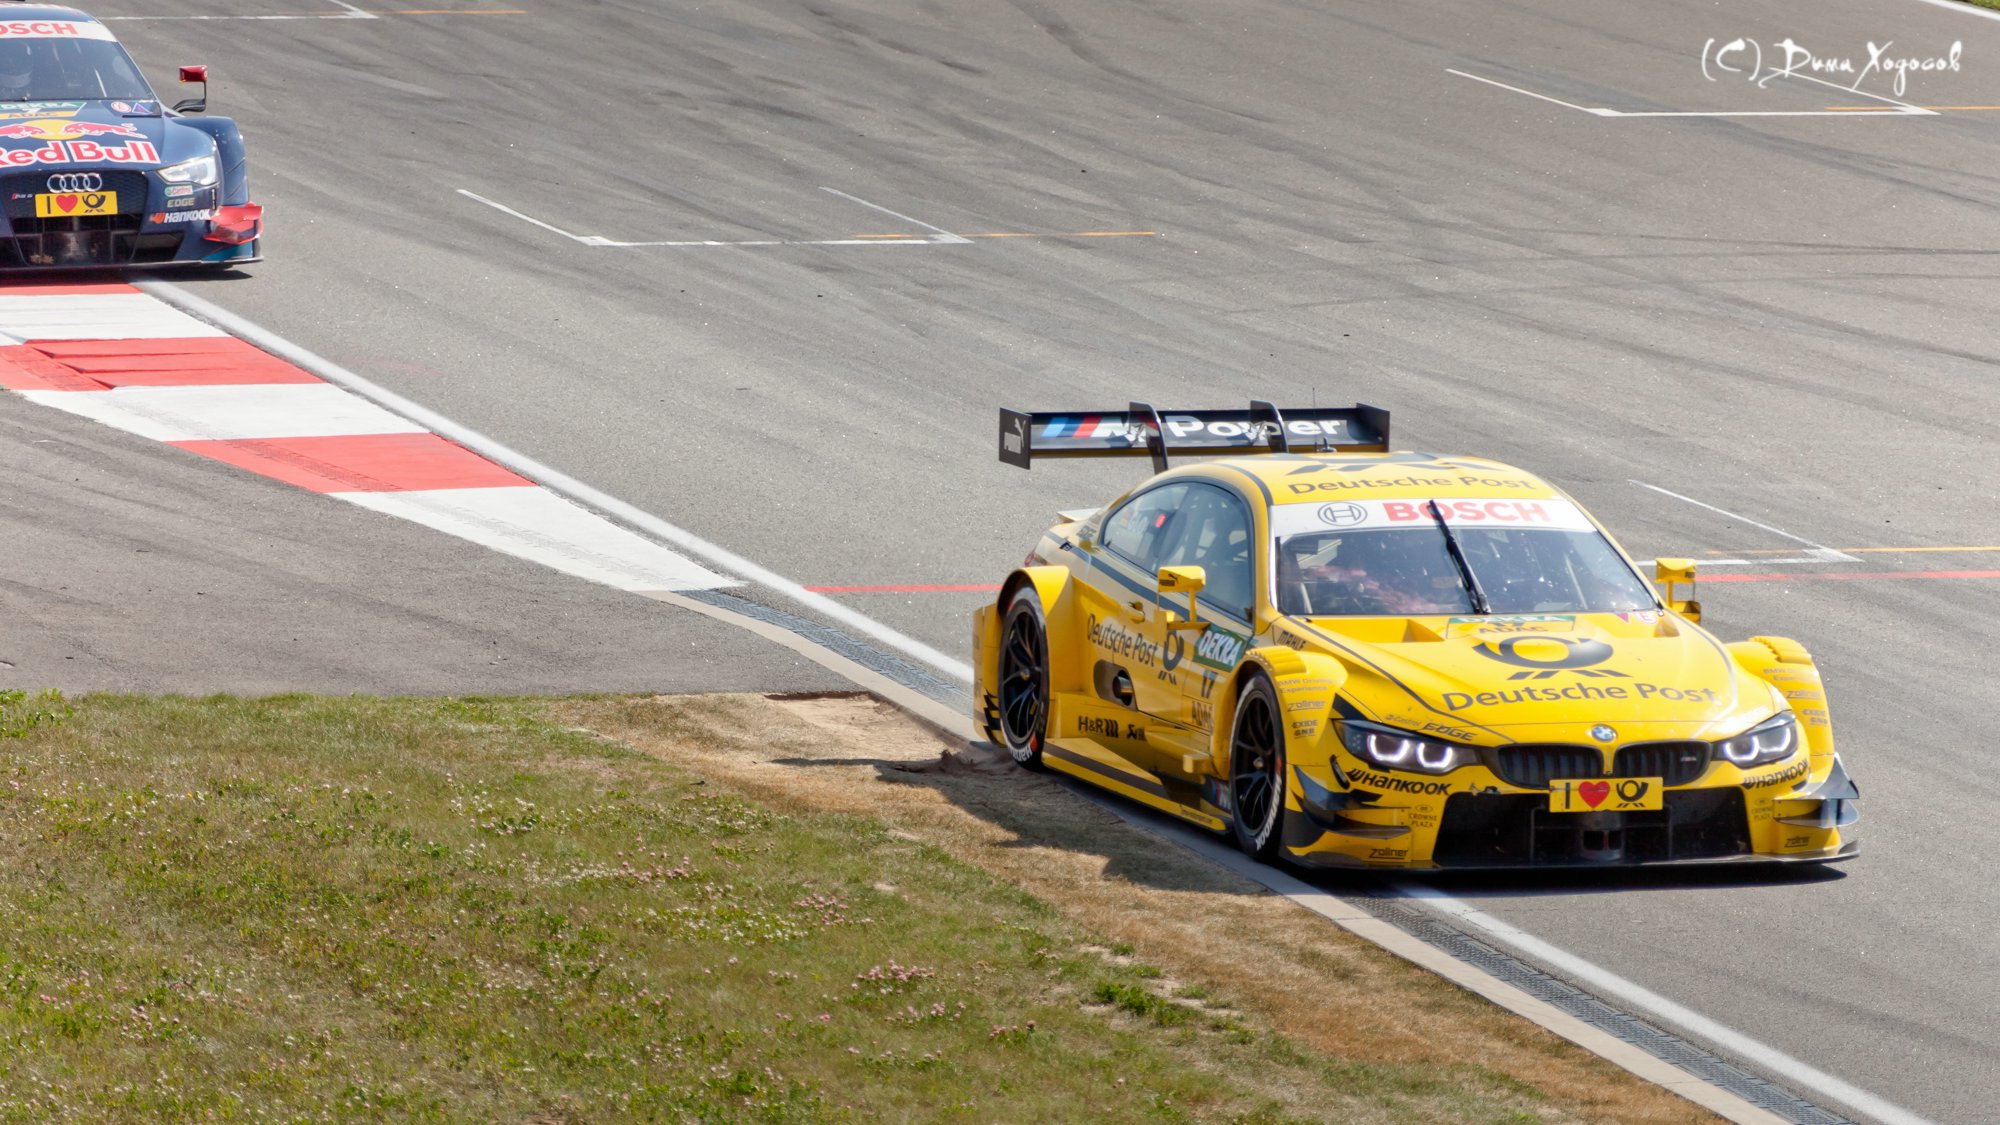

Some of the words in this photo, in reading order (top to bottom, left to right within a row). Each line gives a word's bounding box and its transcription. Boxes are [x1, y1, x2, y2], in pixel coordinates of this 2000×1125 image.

[67, 142, 160, 163] Bull
[167, 198, 195, 207] EDGE
[1165, 415, 1341, 441] Power
[1288, 476, 1450, 494] Deutsche
[1459, 476, 1536, 490] Post
[1382, 502, 1551, 522] BOSCH
[1087, 614, 1132, 657] Deutsche
[1132, 633, 1158, 667] Post
[1198, 630, 1243, 666] DEKRA
[1442, 682, 1627, 711] Deutsche
[1634, 683, 1716, 703] Post
[1078, 715, 1103, 733] H&R
[1421, 722, 1478, 741] EDGE
[1411, 820, 1433, 828] PLAZA
